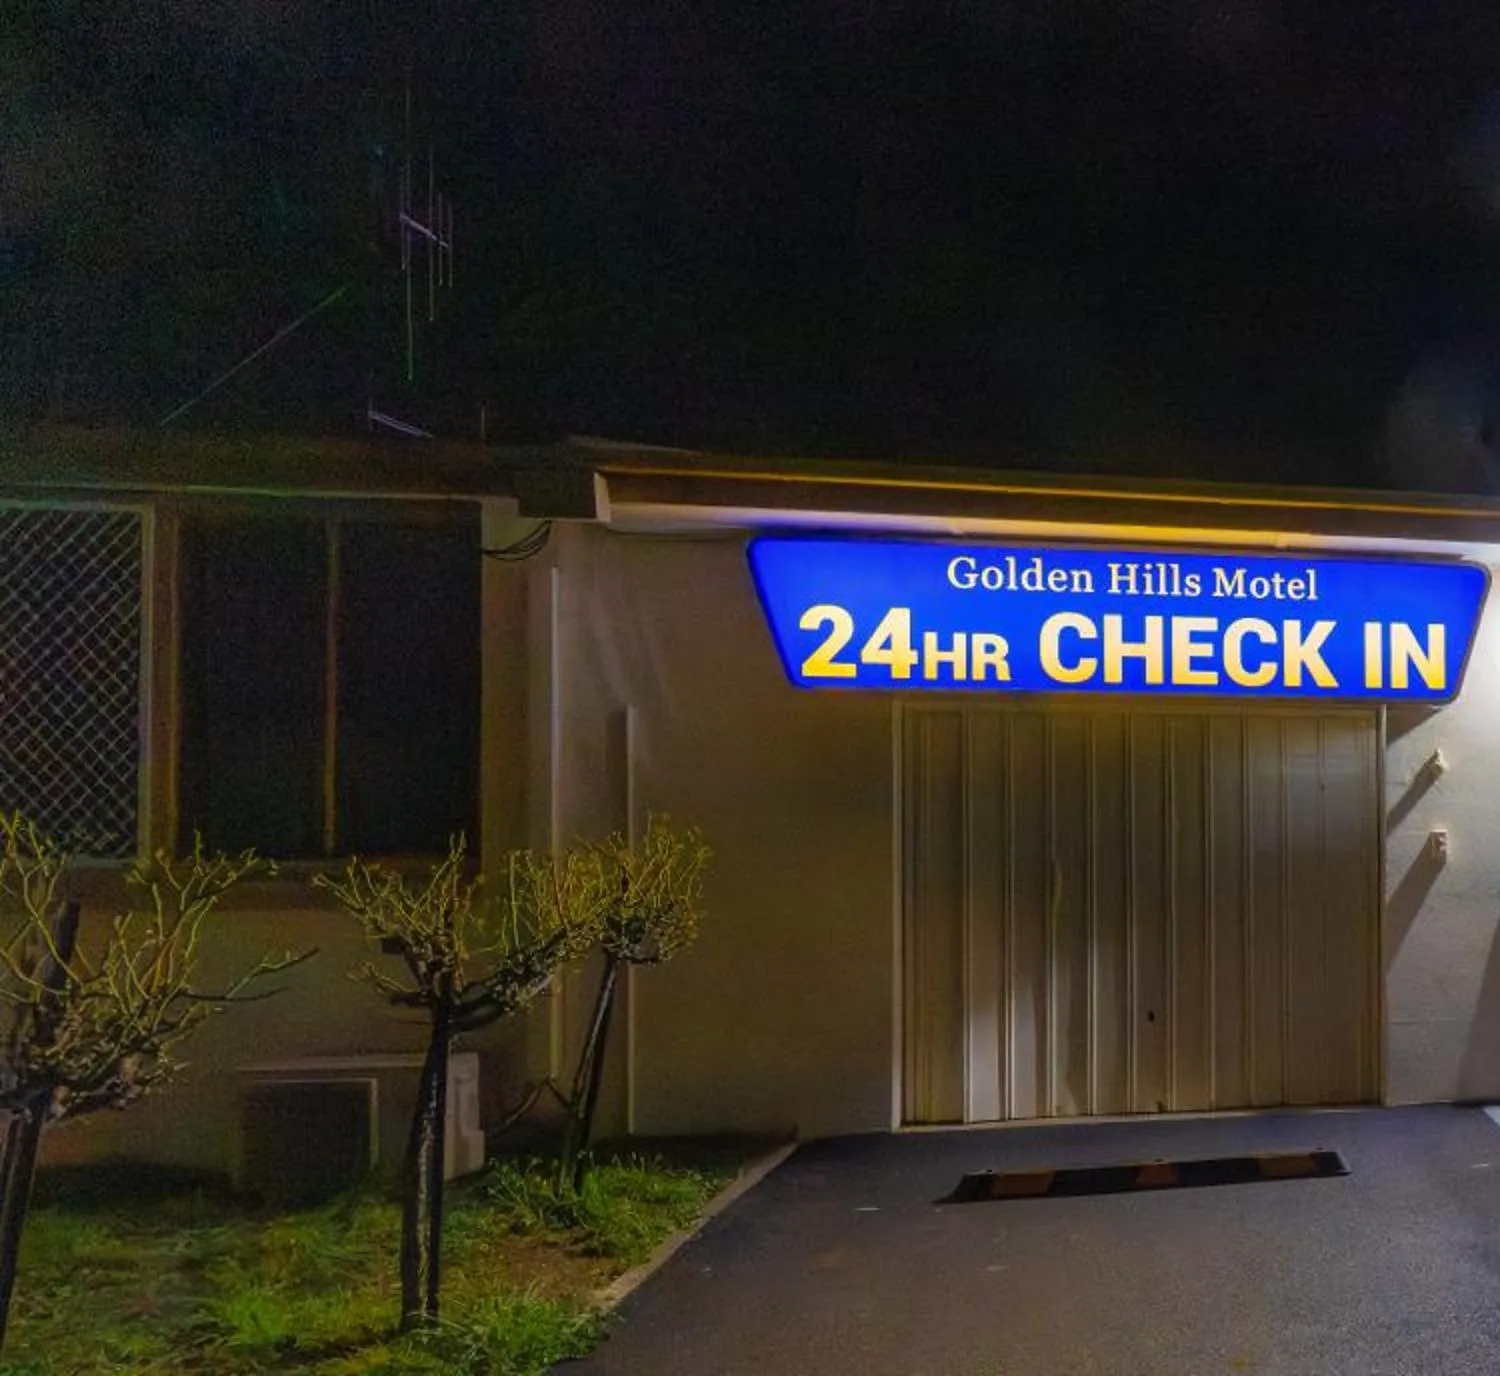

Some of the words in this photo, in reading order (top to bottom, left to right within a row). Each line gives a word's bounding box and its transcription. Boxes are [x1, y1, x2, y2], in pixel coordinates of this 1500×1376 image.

[946, 555, 1094, 593] Golden
[1107, 562, 1202, 598] Hills
[1212, 567, 1318, 601] Motel
[798, 604, 1012, 682] 24HR
[1039, 610, 1339, 688] CHECK
[1364, 621, 1446, 690] IN
